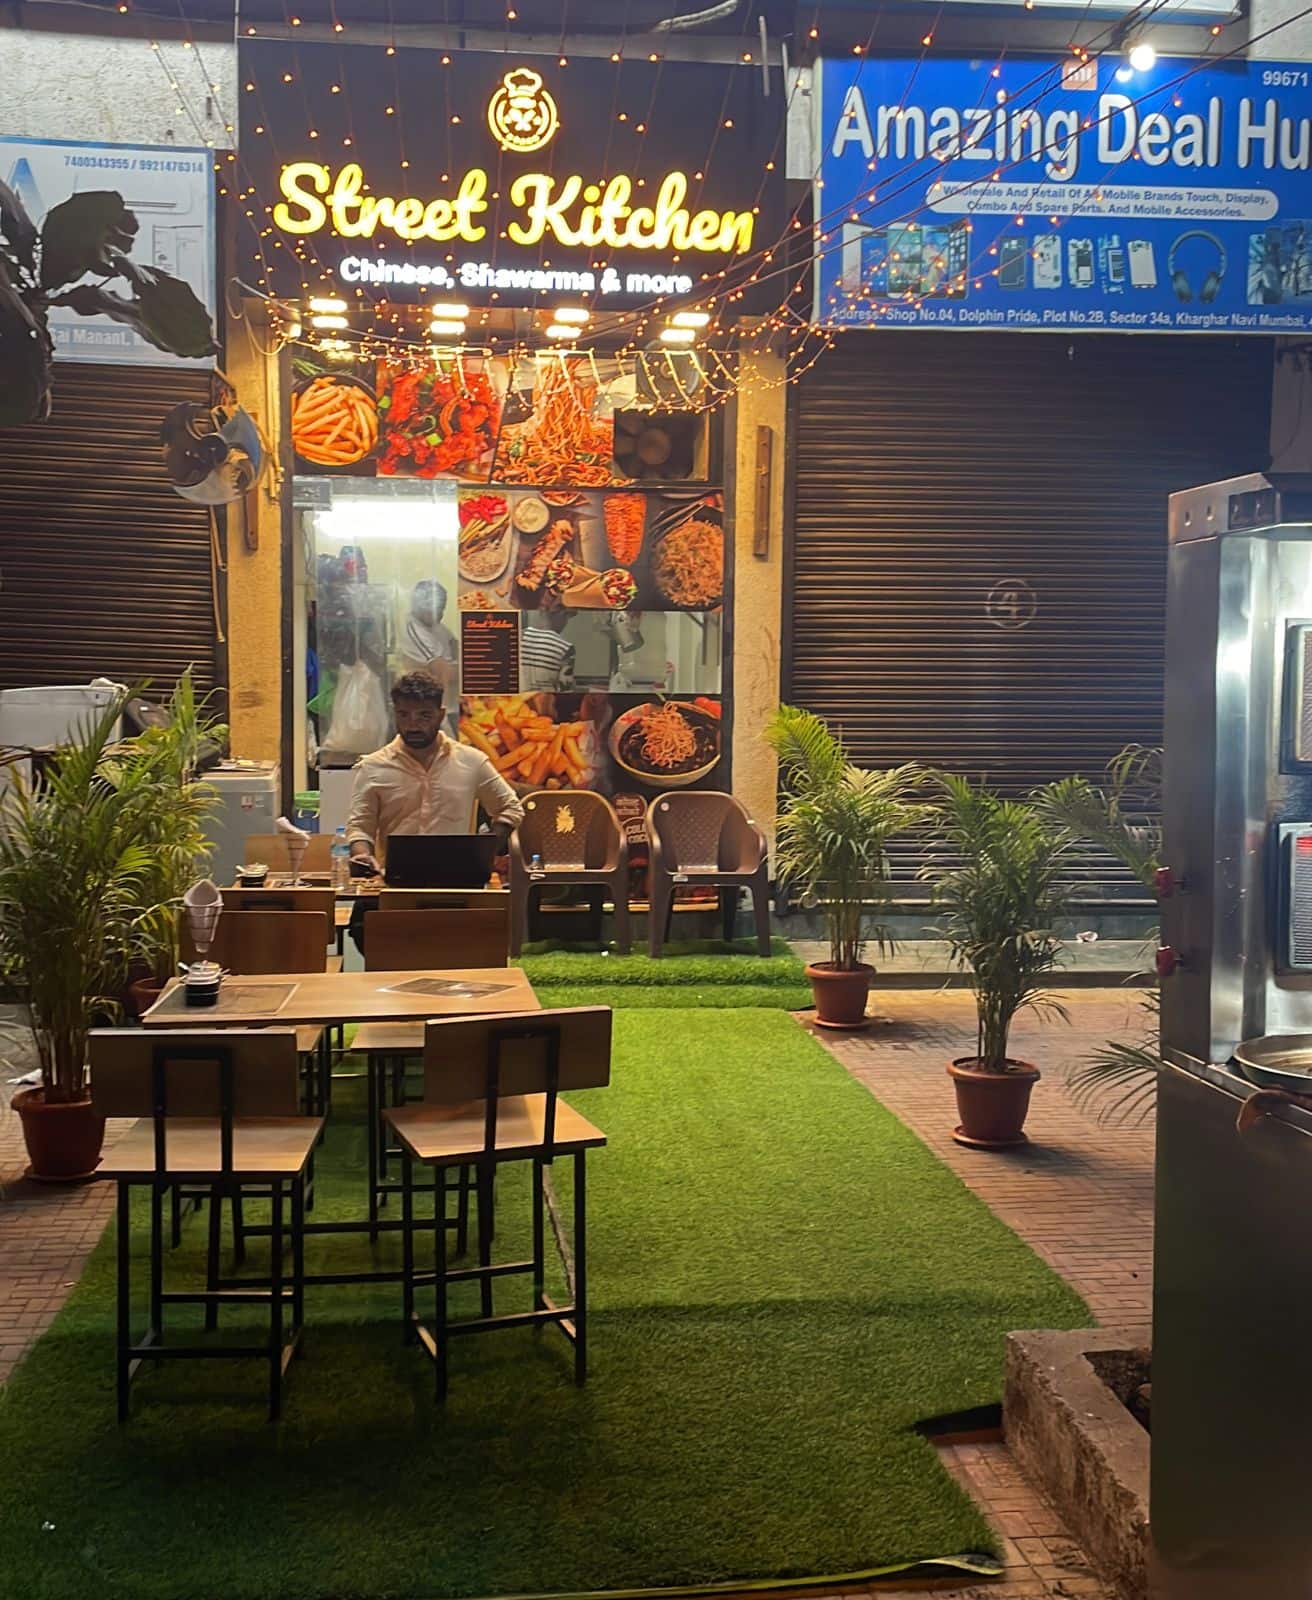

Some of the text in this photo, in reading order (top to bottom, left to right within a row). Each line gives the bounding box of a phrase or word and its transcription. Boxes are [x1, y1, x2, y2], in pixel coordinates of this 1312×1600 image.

[1263, 71, 1309, 87] 99671
[832, 86, 1078, 182] Amazing
[1098, 94, 1220, 168] Deal
[1006, 187, 1028, 198] And
[1032, 188, 1065, 199] Retail
[1068, 189, 1081, 199] Of
[1102, 190, 1140, 201] Mobile
[1144, 191, 1183, 202] Brands
[273, 162, 754, 253] Street Kitchen
[967, 200, 1007, 211] Combo
[1011, 201, 1032, 212] And
[1036, 202, 1068, 213] Spare
[1108, 204, 1129, 214] And
[1133, 205, 1171, 216] Mobile
[339, 256, 693, 293] Chinese, Shawarma & more
[887, 308, 916, 323] Shop
[959, 310, 1005, 324] Dolphin
[1043, 311, 1067, 323] Plot
[1110, 312, 1147, 324] Sector
[1176, 313, 1229, 327] Kharghar
[1232, 313, 1257, 326] Navi
